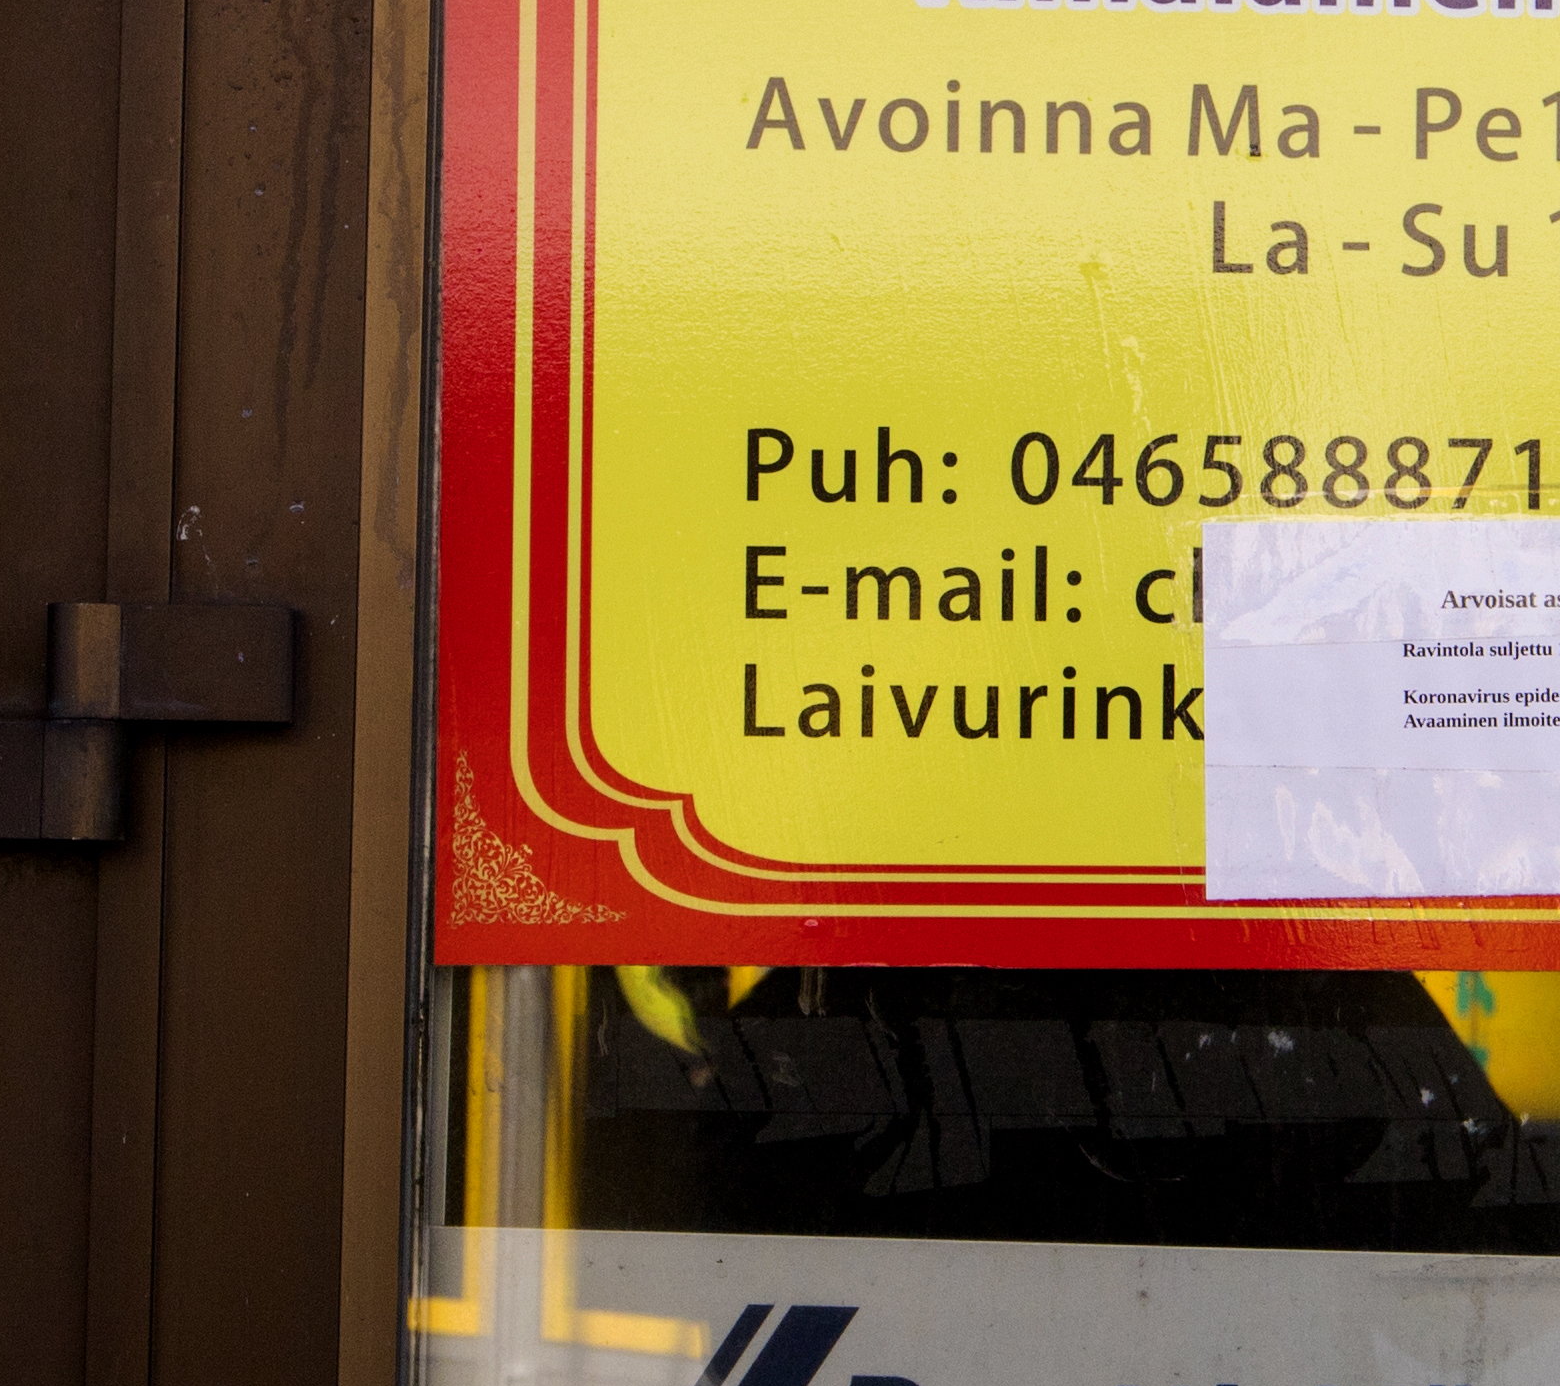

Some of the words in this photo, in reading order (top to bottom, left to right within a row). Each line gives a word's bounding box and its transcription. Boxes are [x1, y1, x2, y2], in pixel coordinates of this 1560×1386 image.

[744, 75, 1153, 158] Avoinna
[1186, 82, 1321, 160] Ma
[1211, 199, 1310, 277] La
[1400, 201, 1510, 280] Su
[745, 425, 959, 506] Puh:
[744, 544, 1083, 625] E-mail:
[1441, 589, 1537, 610] Arvoisat
[1402, 641, 1485, 658] Ravintola
[1489, 640, 1553, 661] suljettu
[1403, 688, 1511, 705] Koronavirus
[1403, 712, 1498, 729] Avaaminen
